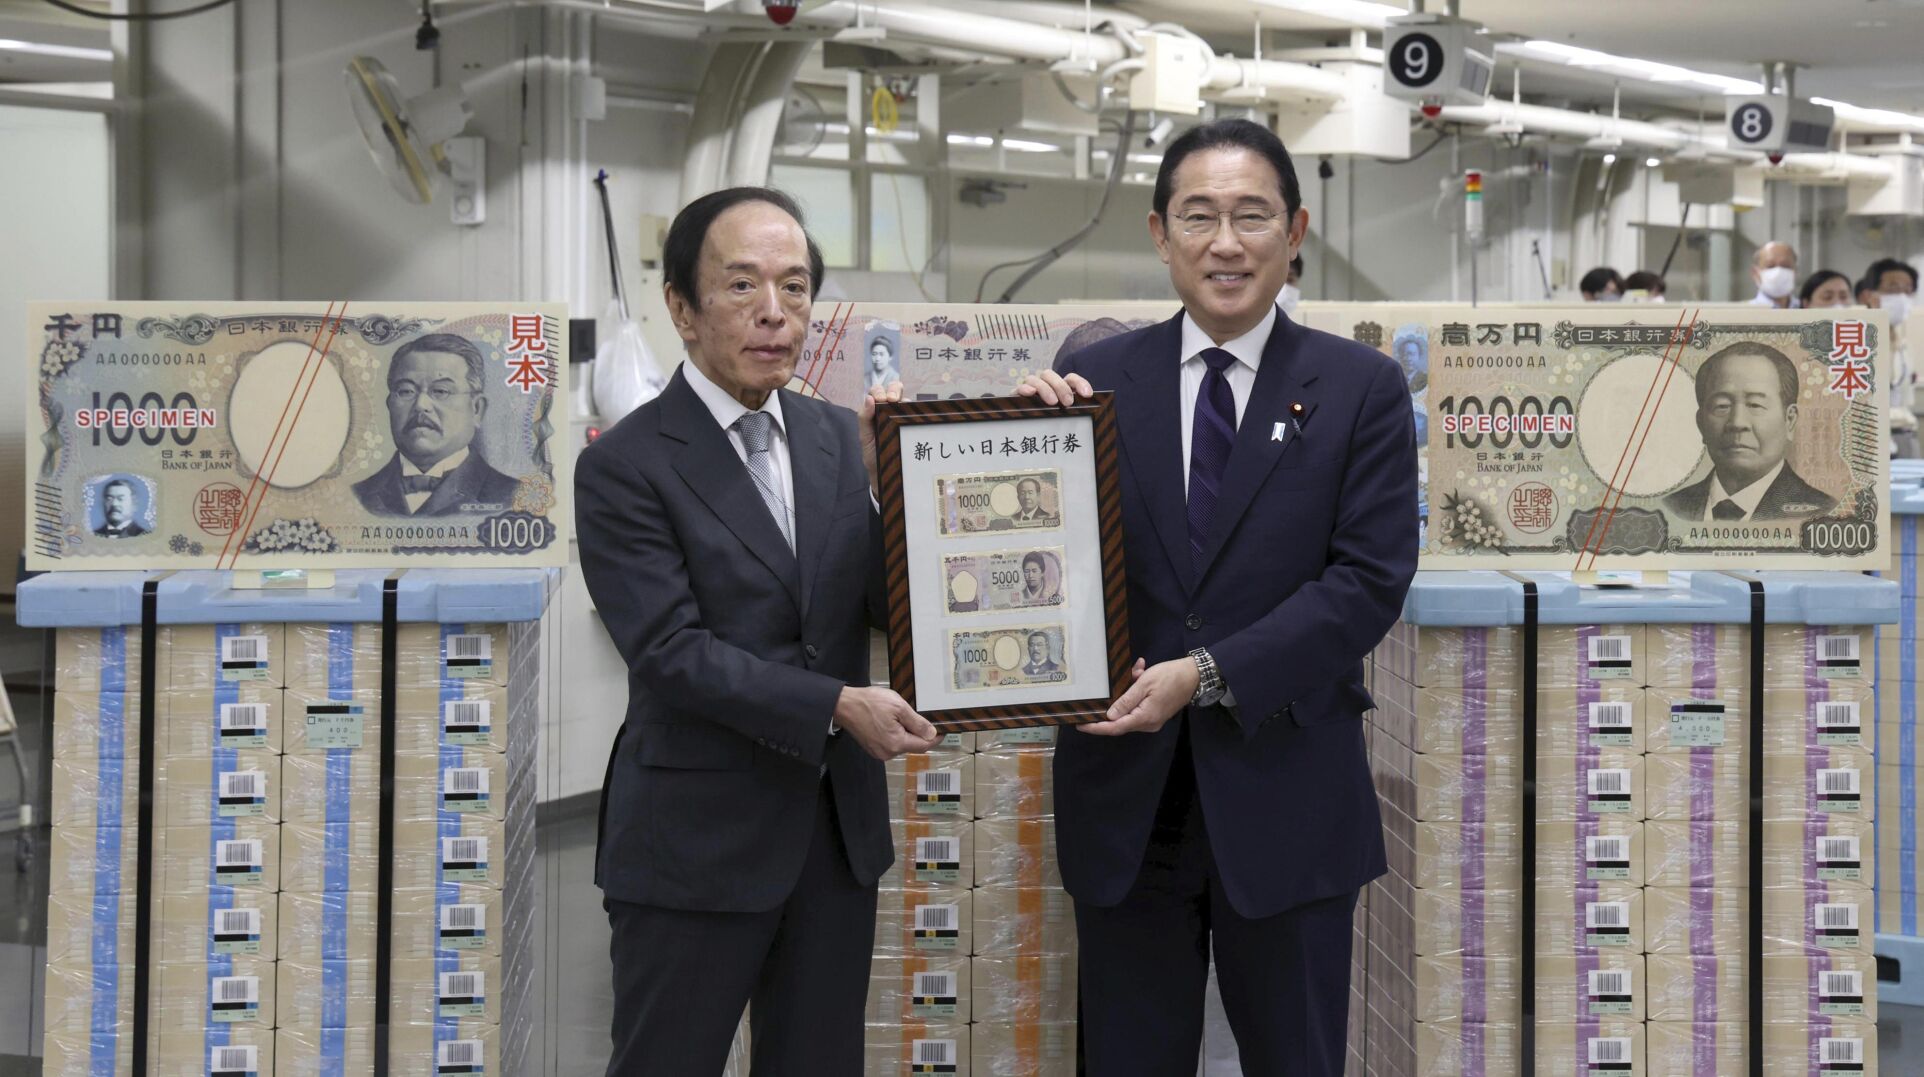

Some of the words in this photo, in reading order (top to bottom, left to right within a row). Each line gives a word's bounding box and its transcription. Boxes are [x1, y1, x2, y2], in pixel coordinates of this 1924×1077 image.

[1404, 41, 1429, 79] 9
[1741, 107, 1762, 138] 8
[507, 313, 547, 392] 見本
[915, 347, 1031, 361] 日本銀行券
[1831, 321, 1868, 398] 見本
[77, 410, 215, 427] SPECIMEN
[92, 391, 198, 446] 1000
[1439, 395, 1574, 449] 10000
[1444, 415, 1573, 432] SPECIMEN
[161, 450, 232, 459] 日本銀行
[914, 432, 1083, 461] 新しい日本銀行券
[1476, 452, 1544, 461] 日本銀行
[958, 493, 990, 508] 10000
[490, 518, 545, 548] 1000
[1807, 523, 1870, 549] 10000
[992, 570, 1020, 585] 5000
[964, 649, 988, 663] 1000
